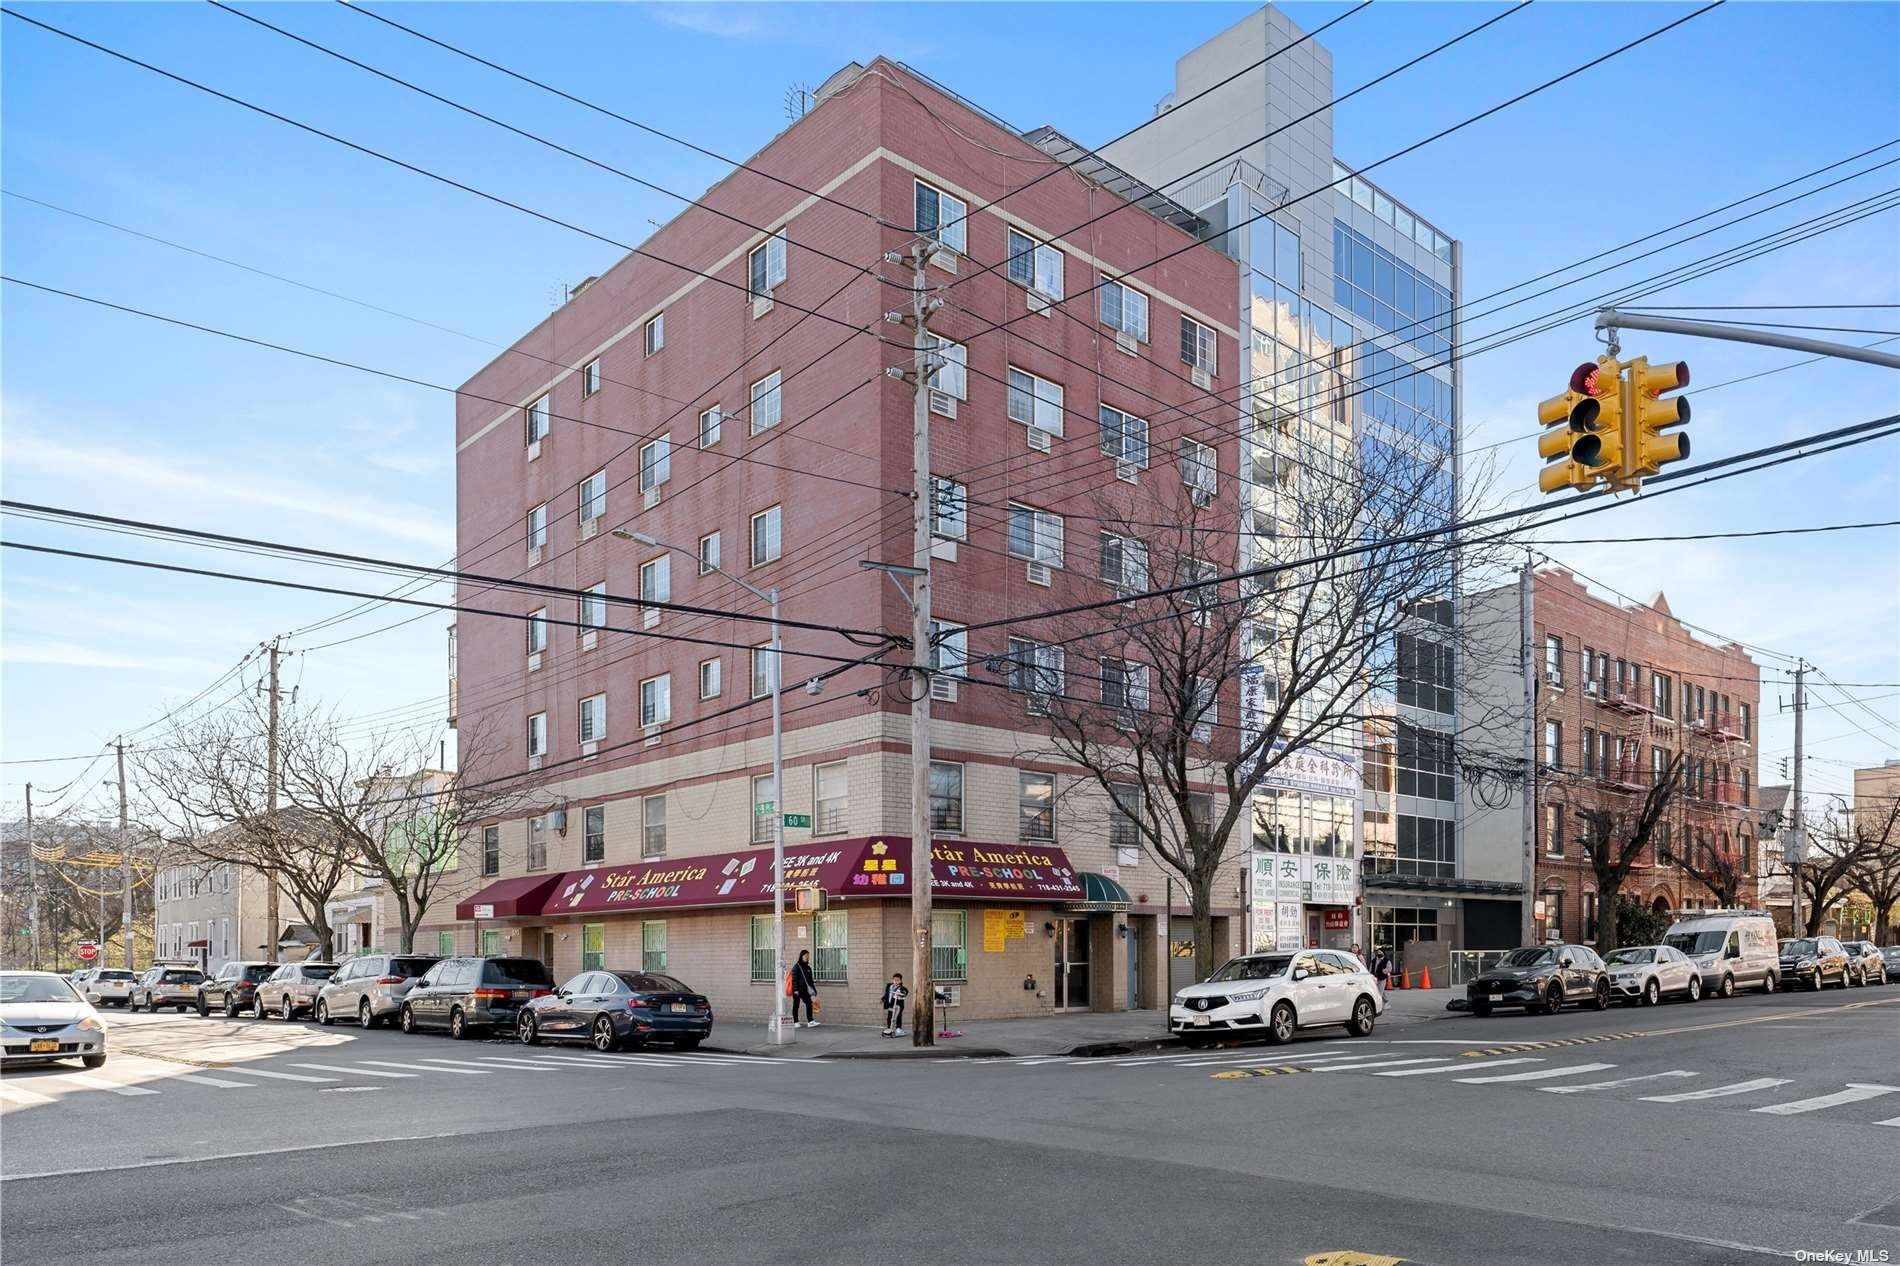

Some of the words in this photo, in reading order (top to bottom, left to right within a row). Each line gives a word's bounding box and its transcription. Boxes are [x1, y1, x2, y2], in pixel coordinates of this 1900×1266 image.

[788, 815, 798, 826] 60
[794, 854, 810, 868] 3K
[807, 852, 827, 866] and
[826, 850, 842, 864] 4K
[930, 844, 964, 861] tar
[973, 847, 1053, 866] America
[637, 865, 708, 885] America
[947, 865, 1044, 880] PRE-SCHOOL
[940, 879, 950, 887] 3K
[951, 880, 964, 888] and
[1279, 880, 1300, 889] INSURANCE
[606, 885, 681, 902] PRE-SCHOOL
